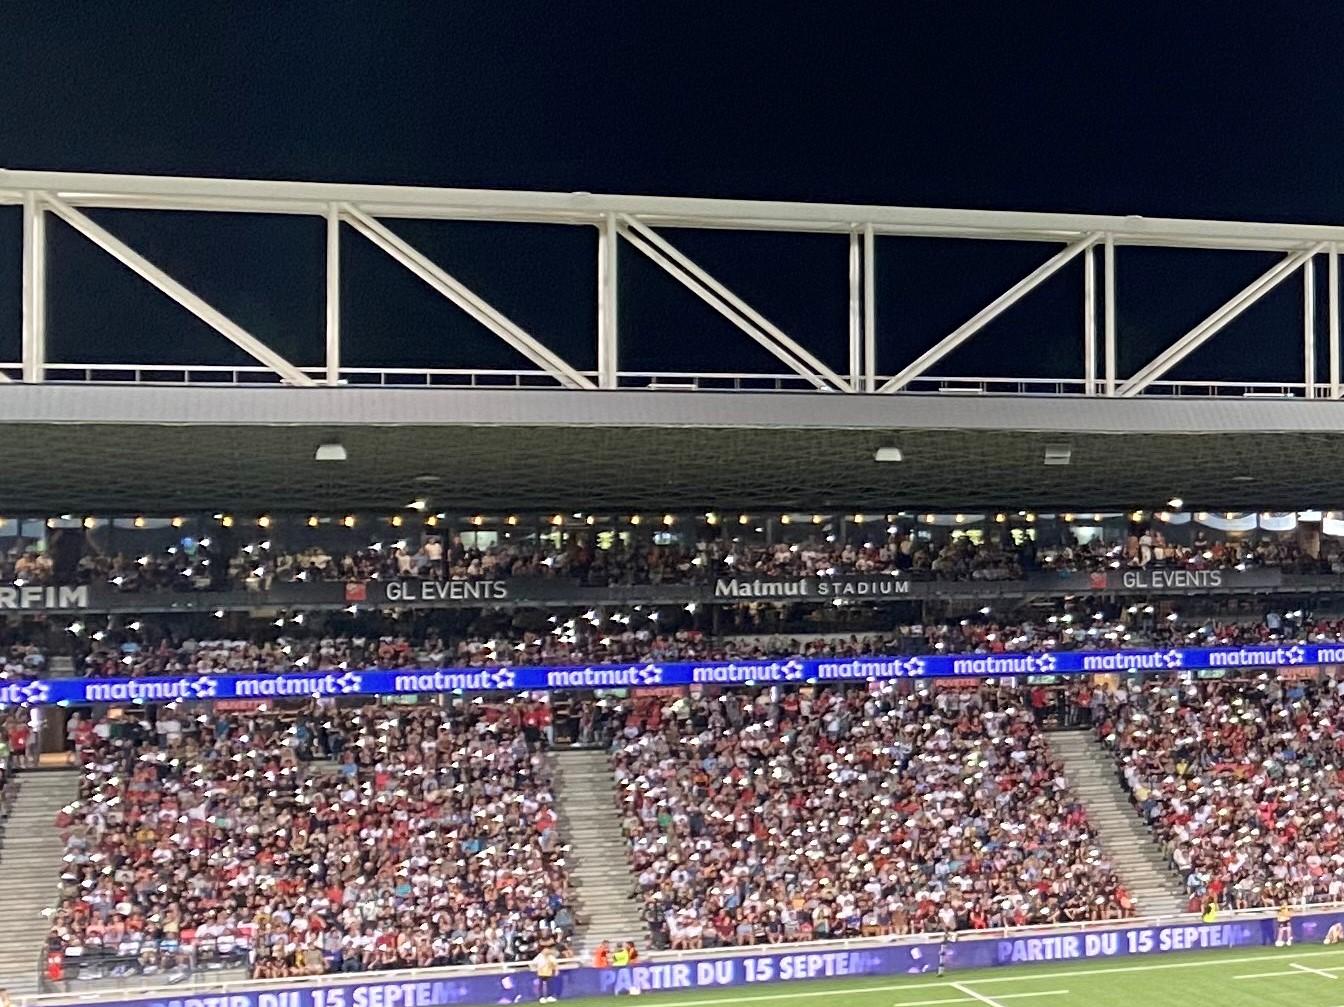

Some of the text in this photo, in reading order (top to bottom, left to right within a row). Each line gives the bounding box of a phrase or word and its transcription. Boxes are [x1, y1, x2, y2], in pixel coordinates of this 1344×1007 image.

[714, 578, 909, 597] Matmut STADIUM
[1123, 570, 1221, 588] GL EVENTS
[386, 580, 507, 600] GL EVENTS
[954, 655, 1036, 673] matmut
[1084, 652, 1164, 670] matmut
[1210, 648, 1286, 666] matmut
[548, 666, 640, 686] matmut
[693, 662, 782, 682] matmut
[819, 658, 904, 678] matmut
[86, 679, 191, 700] matmut
[236, 674, 337, 695] matmut
[395, 670, 492, 690] matmut
[1001, 935, 1081, 963] PARTIR
[1085, 931, 1117, 957] DU
[1127, 929, 1156, 953] 15
[602, 959, 690, 994] PARTIR
[697, 957, 733, 986] DU
[744, 956, 773, 983] 15
